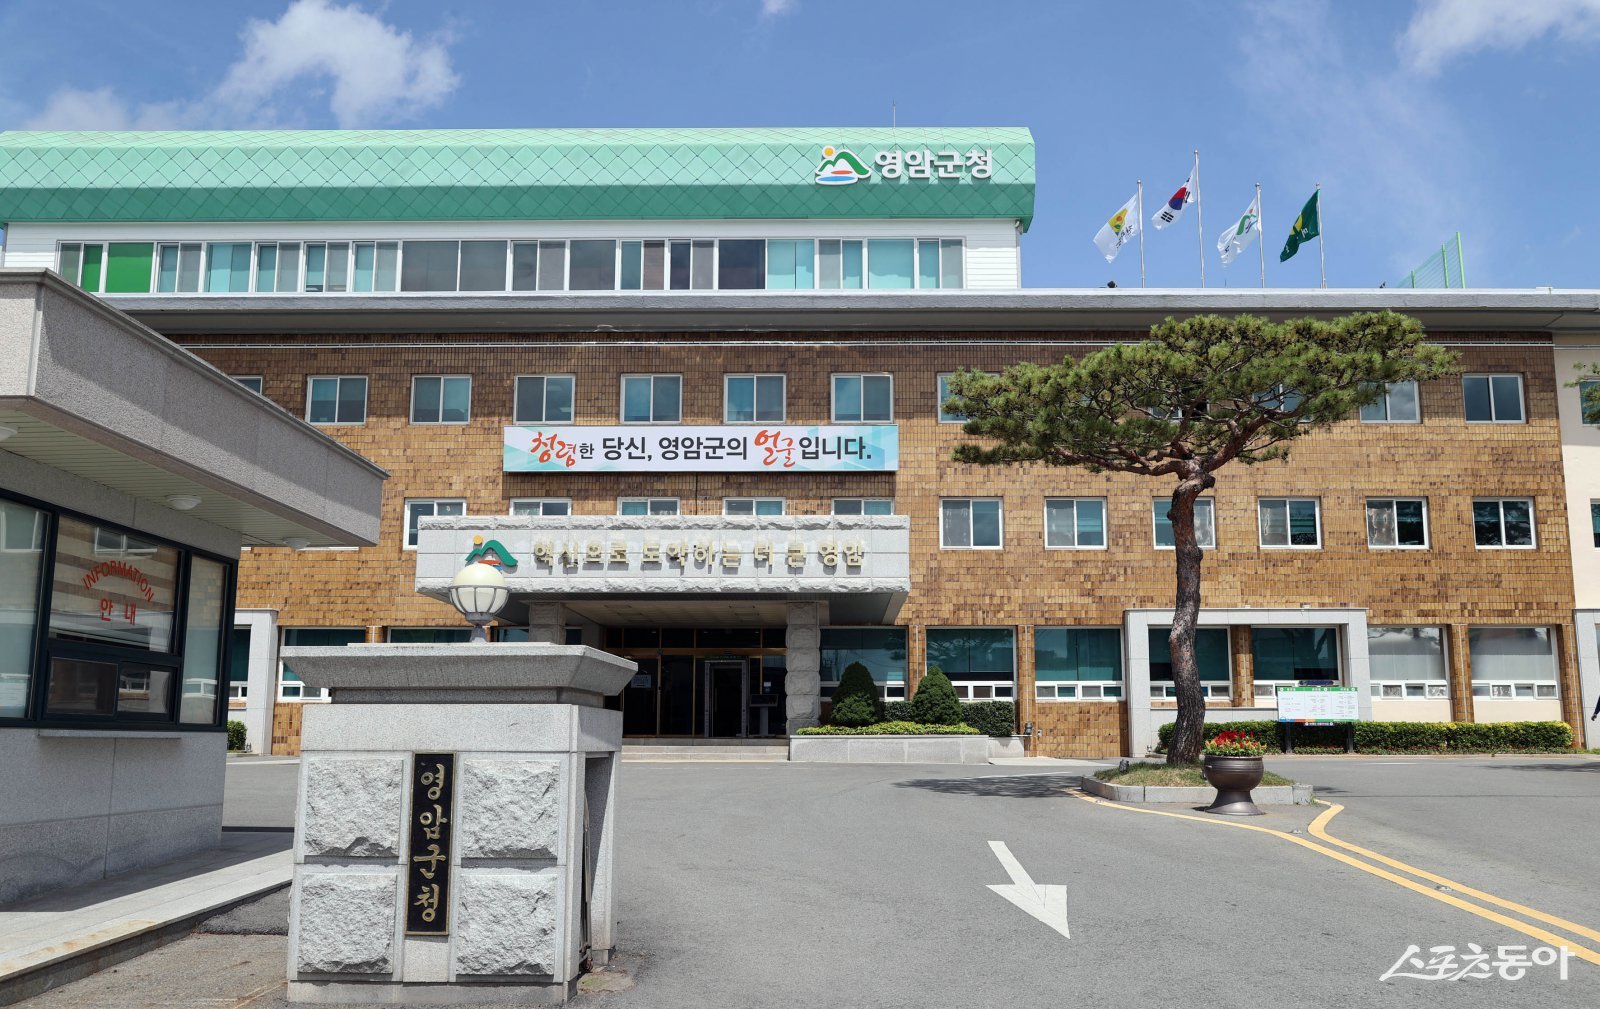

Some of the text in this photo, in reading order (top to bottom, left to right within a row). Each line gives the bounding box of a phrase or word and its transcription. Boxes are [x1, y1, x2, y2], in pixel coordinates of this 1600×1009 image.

[874, 149, 993, 179] 영암군청
[530, 429, 872, 468] 청렴한 당신, 영암군의 얼굴입니다.
[534, 539, 865, 568] 혁신으로 도약하는 더 큰 영암
[81, 560, 155, 603] INFORMATION
[413, 763, 449, 923] 영암군청
